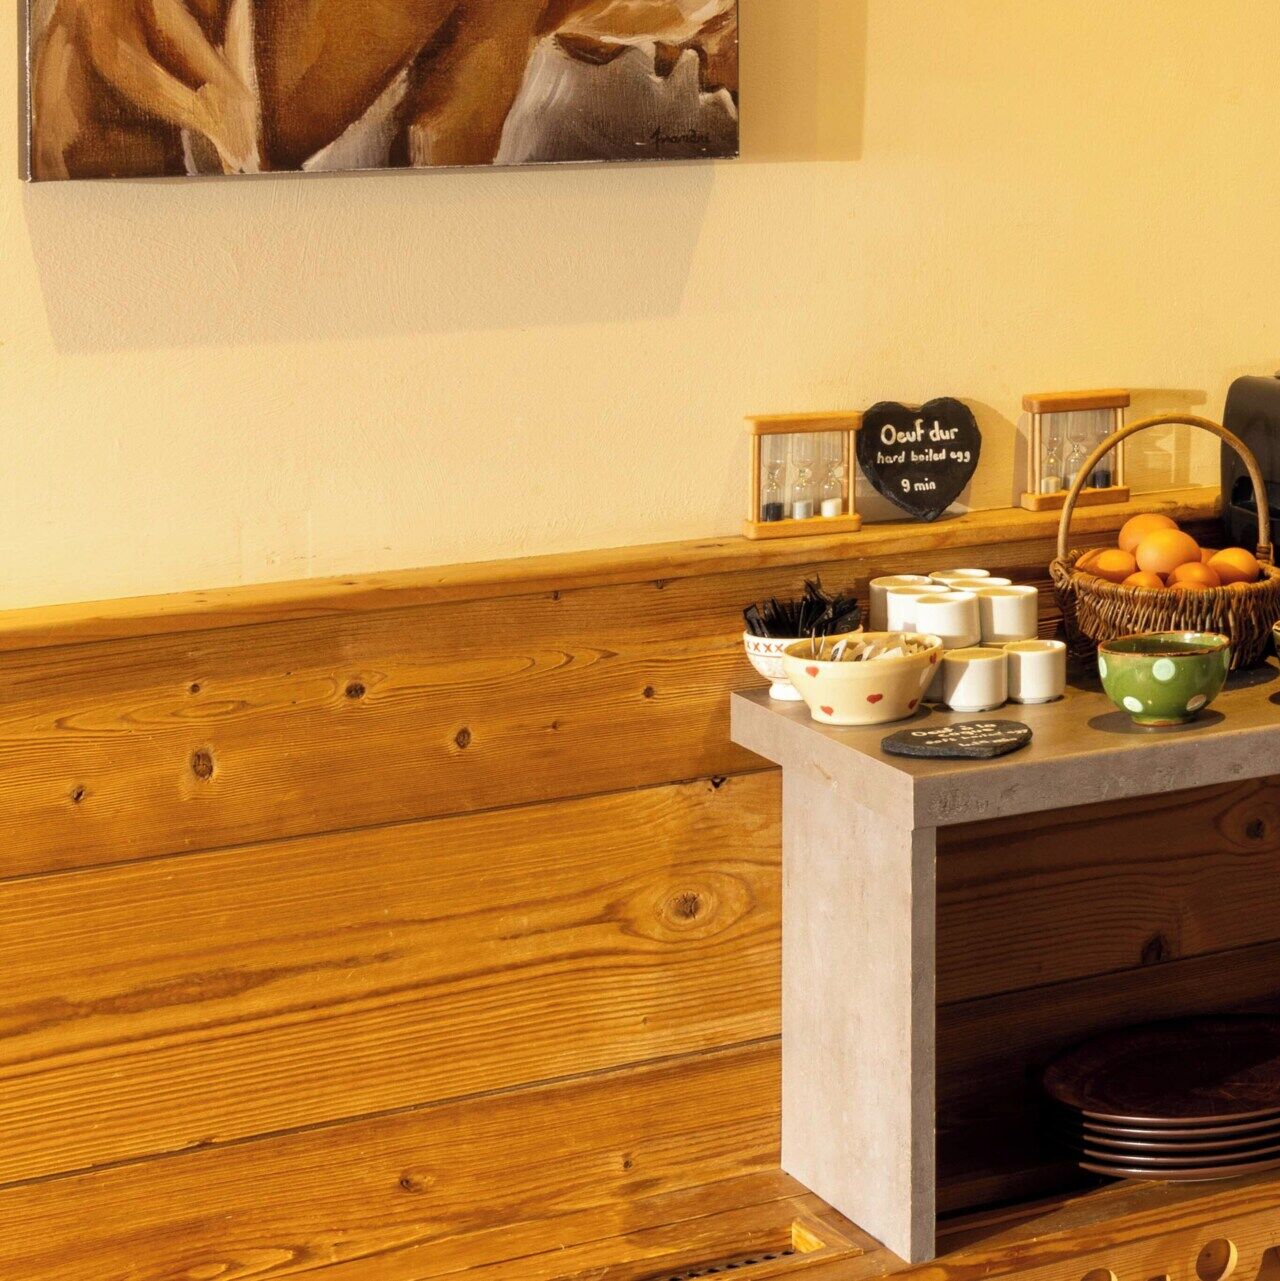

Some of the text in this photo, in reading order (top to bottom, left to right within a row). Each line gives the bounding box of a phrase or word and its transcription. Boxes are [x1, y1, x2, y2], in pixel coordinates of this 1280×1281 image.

[881, 418, 959, 445] Oeuf dur
[877, 448, 971, 464] hard boiled egg
[901, 477, 937, 493] 9 min
